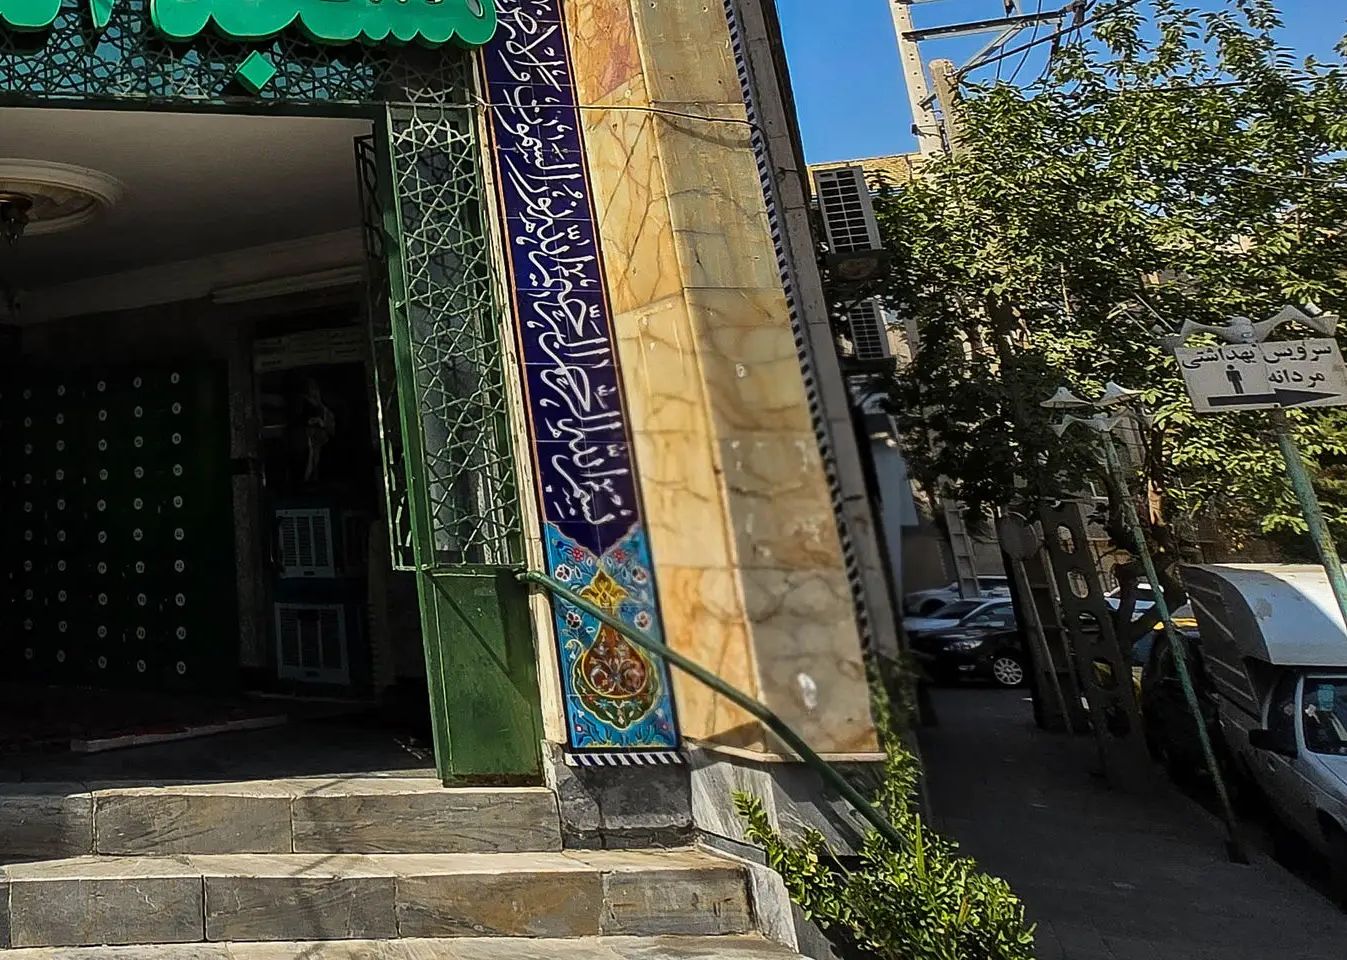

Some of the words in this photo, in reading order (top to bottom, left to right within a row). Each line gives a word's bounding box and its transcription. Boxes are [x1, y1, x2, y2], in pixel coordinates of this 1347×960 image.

[1182, 346, 1257, 369] بهداشتی
[1263, 344, 1333, 364] سرویس
[1268, 368, 1326, 388] مردانه
